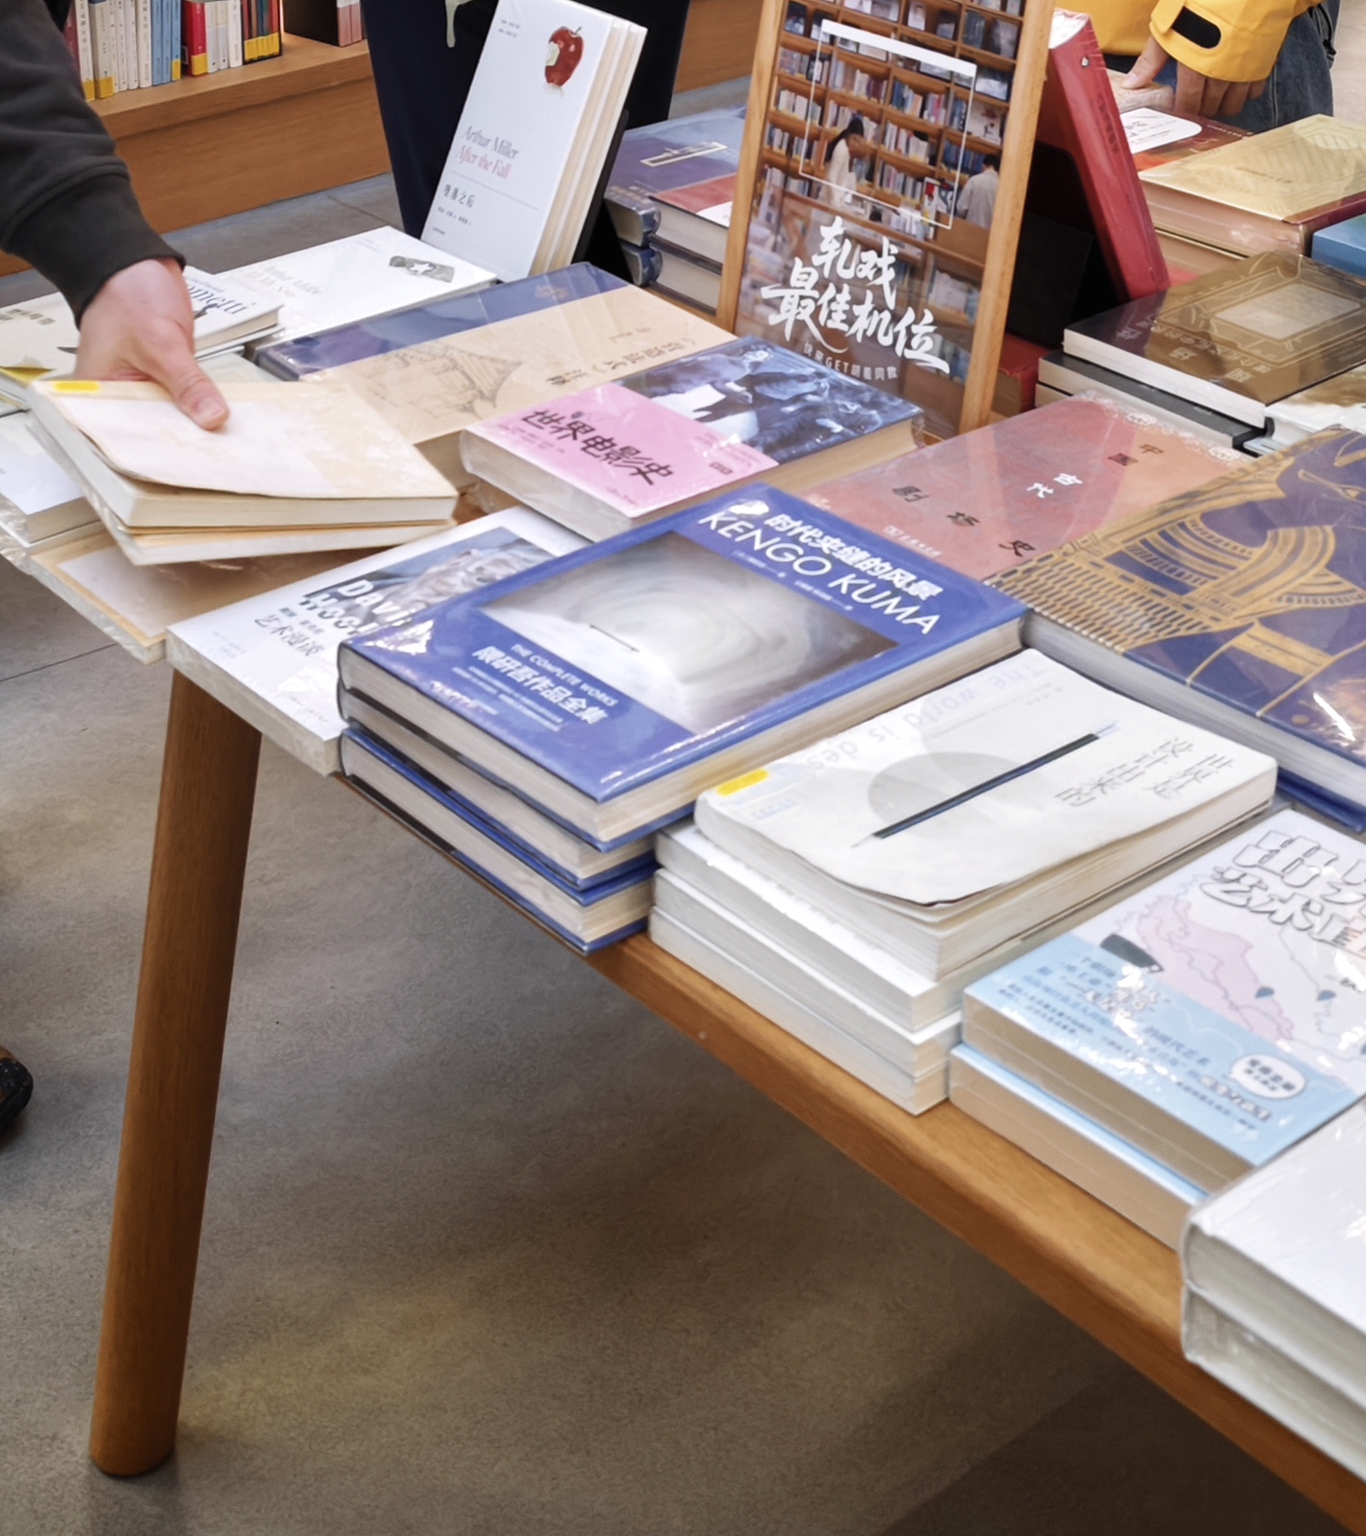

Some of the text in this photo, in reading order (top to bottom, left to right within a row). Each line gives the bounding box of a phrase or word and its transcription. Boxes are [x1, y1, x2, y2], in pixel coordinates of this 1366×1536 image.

[456, 144, 514, 180] After the Fall
[462, 124, 519, 160] Arthur Miller
[761, 257, 951, 375] 最佳机位
[520, 408, 674, 487] 世界电影史
[698, 511, 833, 577] KENGO
[827, 572, 941, 635] KUMA
